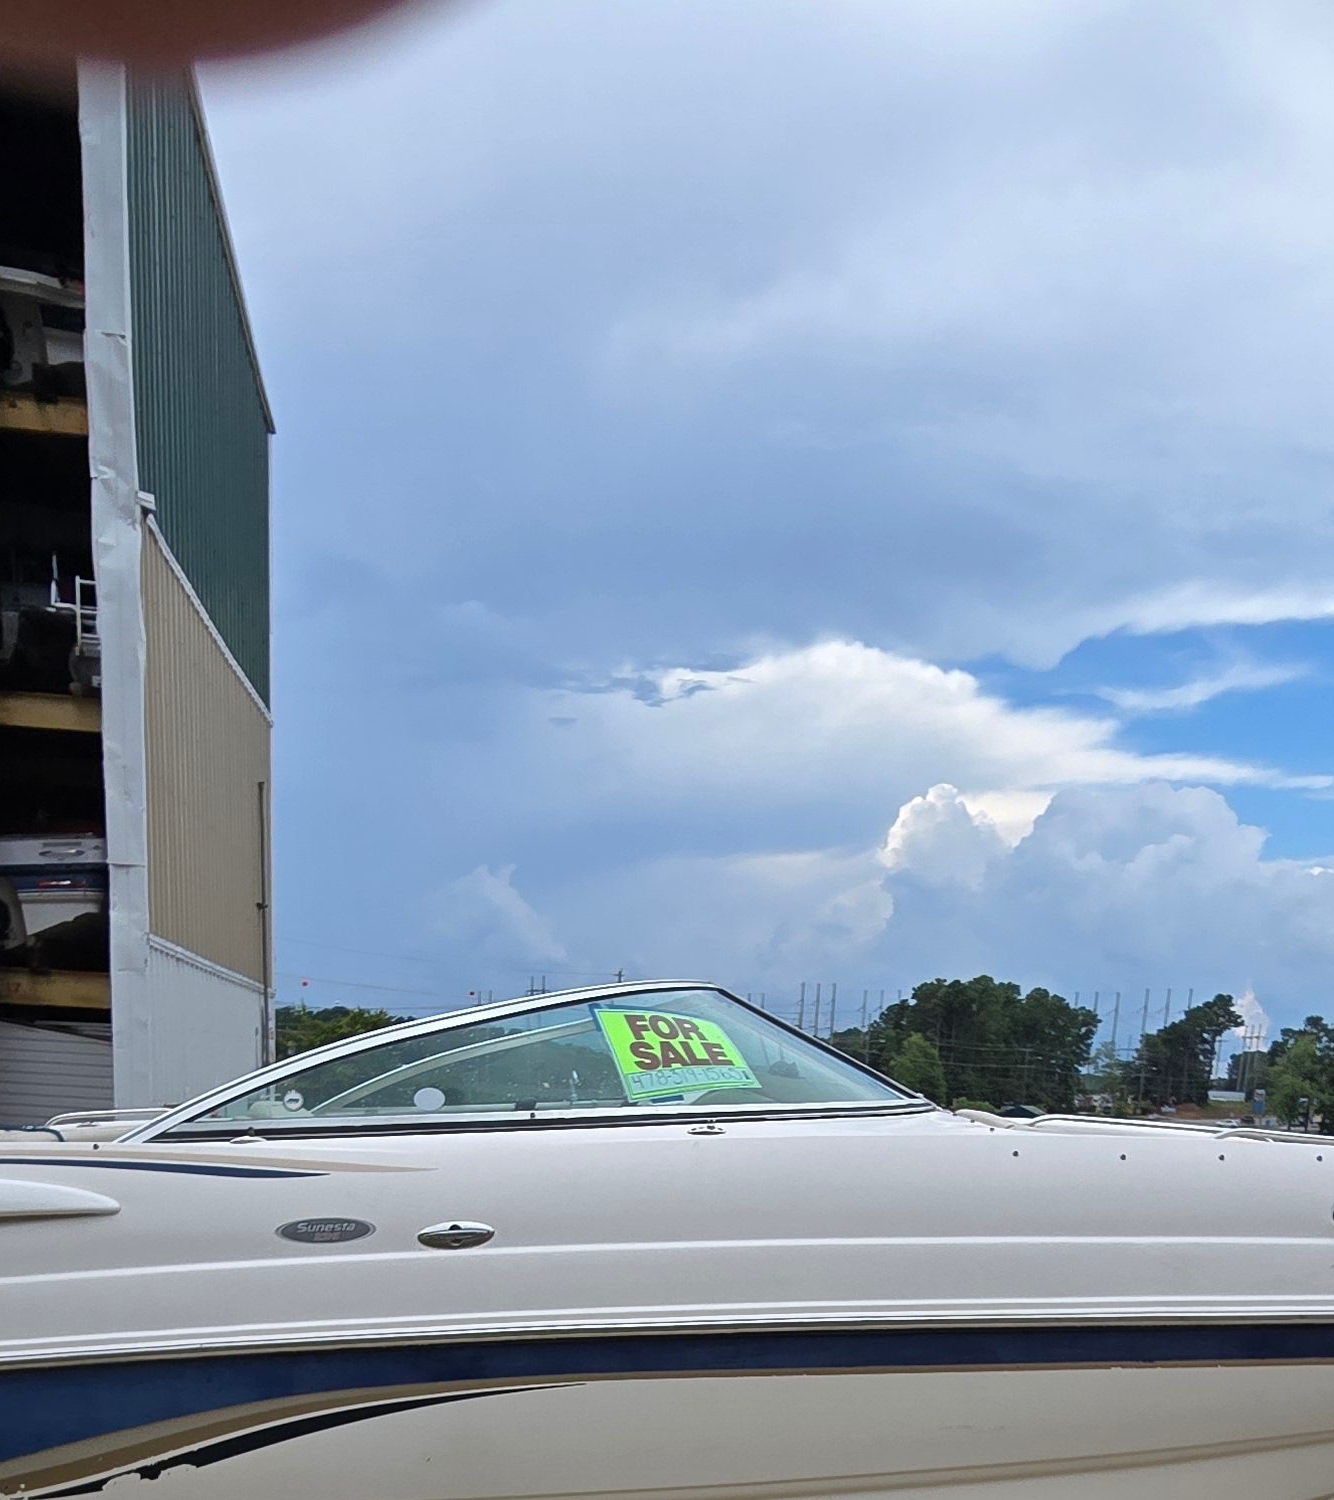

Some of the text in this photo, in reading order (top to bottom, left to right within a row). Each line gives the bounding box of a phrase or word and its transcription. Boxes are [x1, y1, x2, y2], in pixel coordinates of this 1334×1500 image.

[624, 1014, 708, 1041] FOR
[629, 1041, 735, 1070] SALE
[297, 1222, 356, 1233] Sunesta
